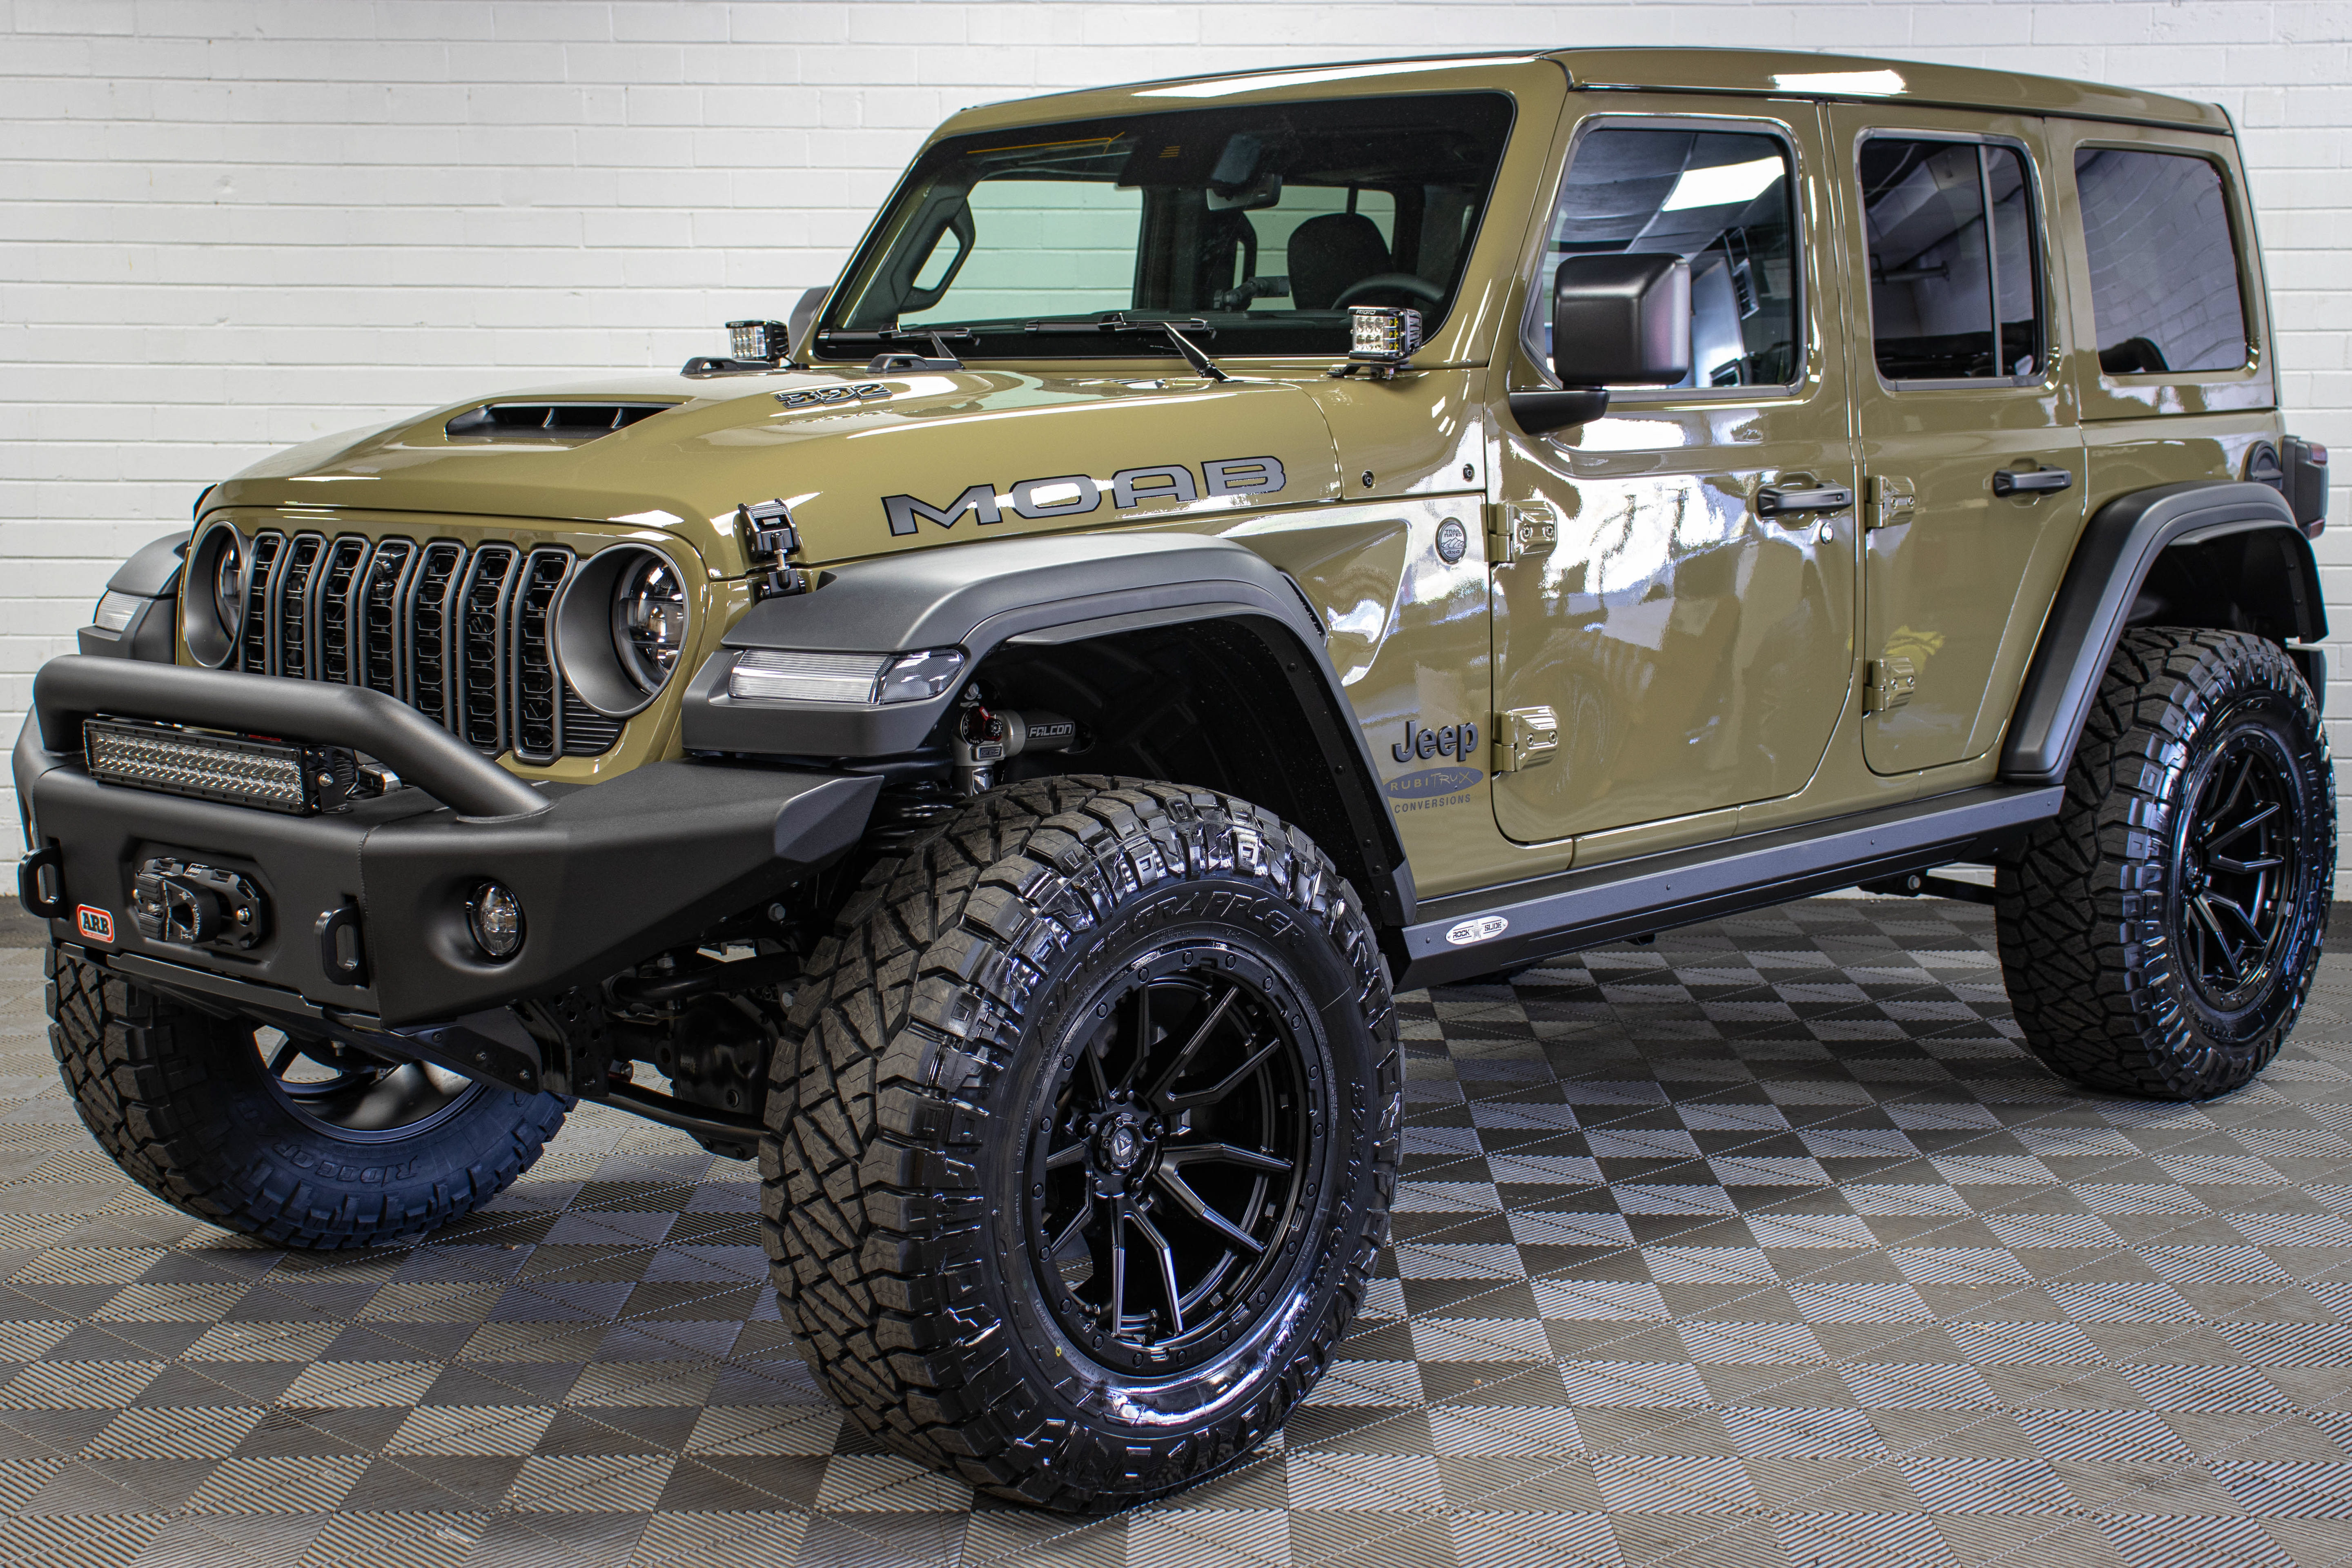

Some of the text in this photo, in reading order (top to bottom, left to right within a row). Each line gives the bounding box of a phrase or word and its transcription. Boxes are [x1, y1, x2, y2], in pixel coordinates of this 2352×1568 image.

[774, 383, 893, 409] 392
[880, 454, 1287, 537] MOAB
[1029, 724, 1072, 737] FALCON
[1392, 719, 1478, 763] Jeep
[294, 765, 304, 802] RIGID
[1390, 771, 1474, 791] RUBITRUX
[1394, 793, 1471, 814] CONVERSIONS
[82, 912, 110, 935] ARB
[1131, 891, 1306, 948] GRAPPLER
[1452, 921, 1502, 939] ROCK SLIDE
